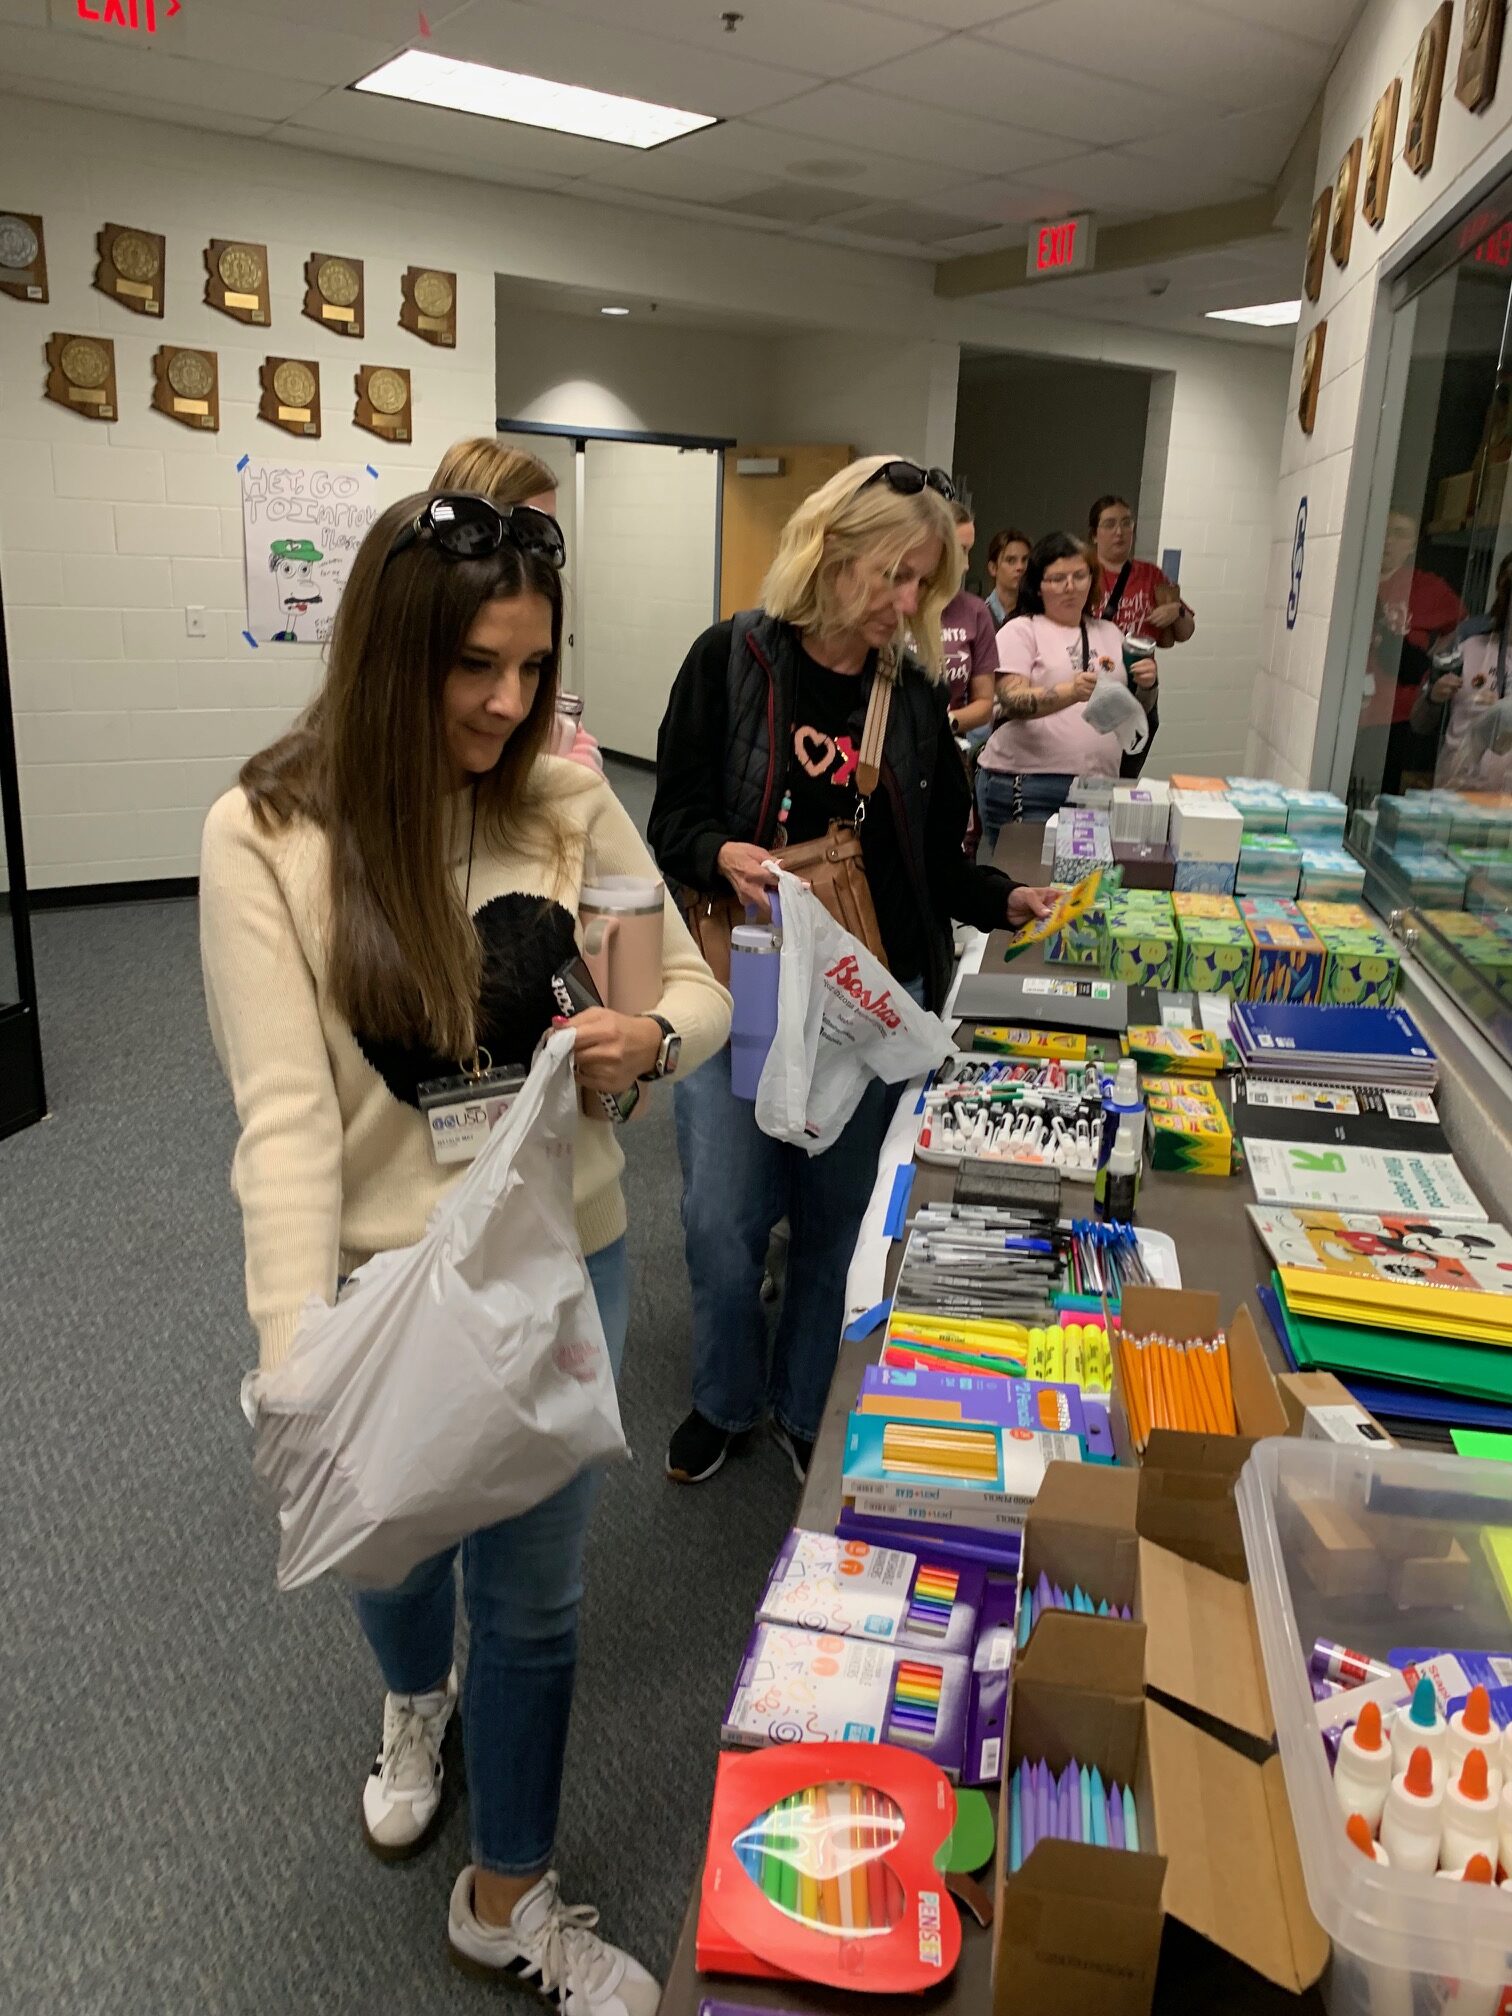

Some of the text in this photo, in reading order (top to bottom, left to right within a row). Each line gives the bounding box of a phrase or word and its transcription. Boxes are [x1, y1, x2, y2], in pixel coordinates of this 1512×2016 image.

[1037, 222, 1077, 271] EXIT
[309, 470, 360, 499] GO
[244, 494, 292, 524] TO
[1388, 1180, 1419, 1210] paper
[1016, 1392, 1034, 1427] Pencils
